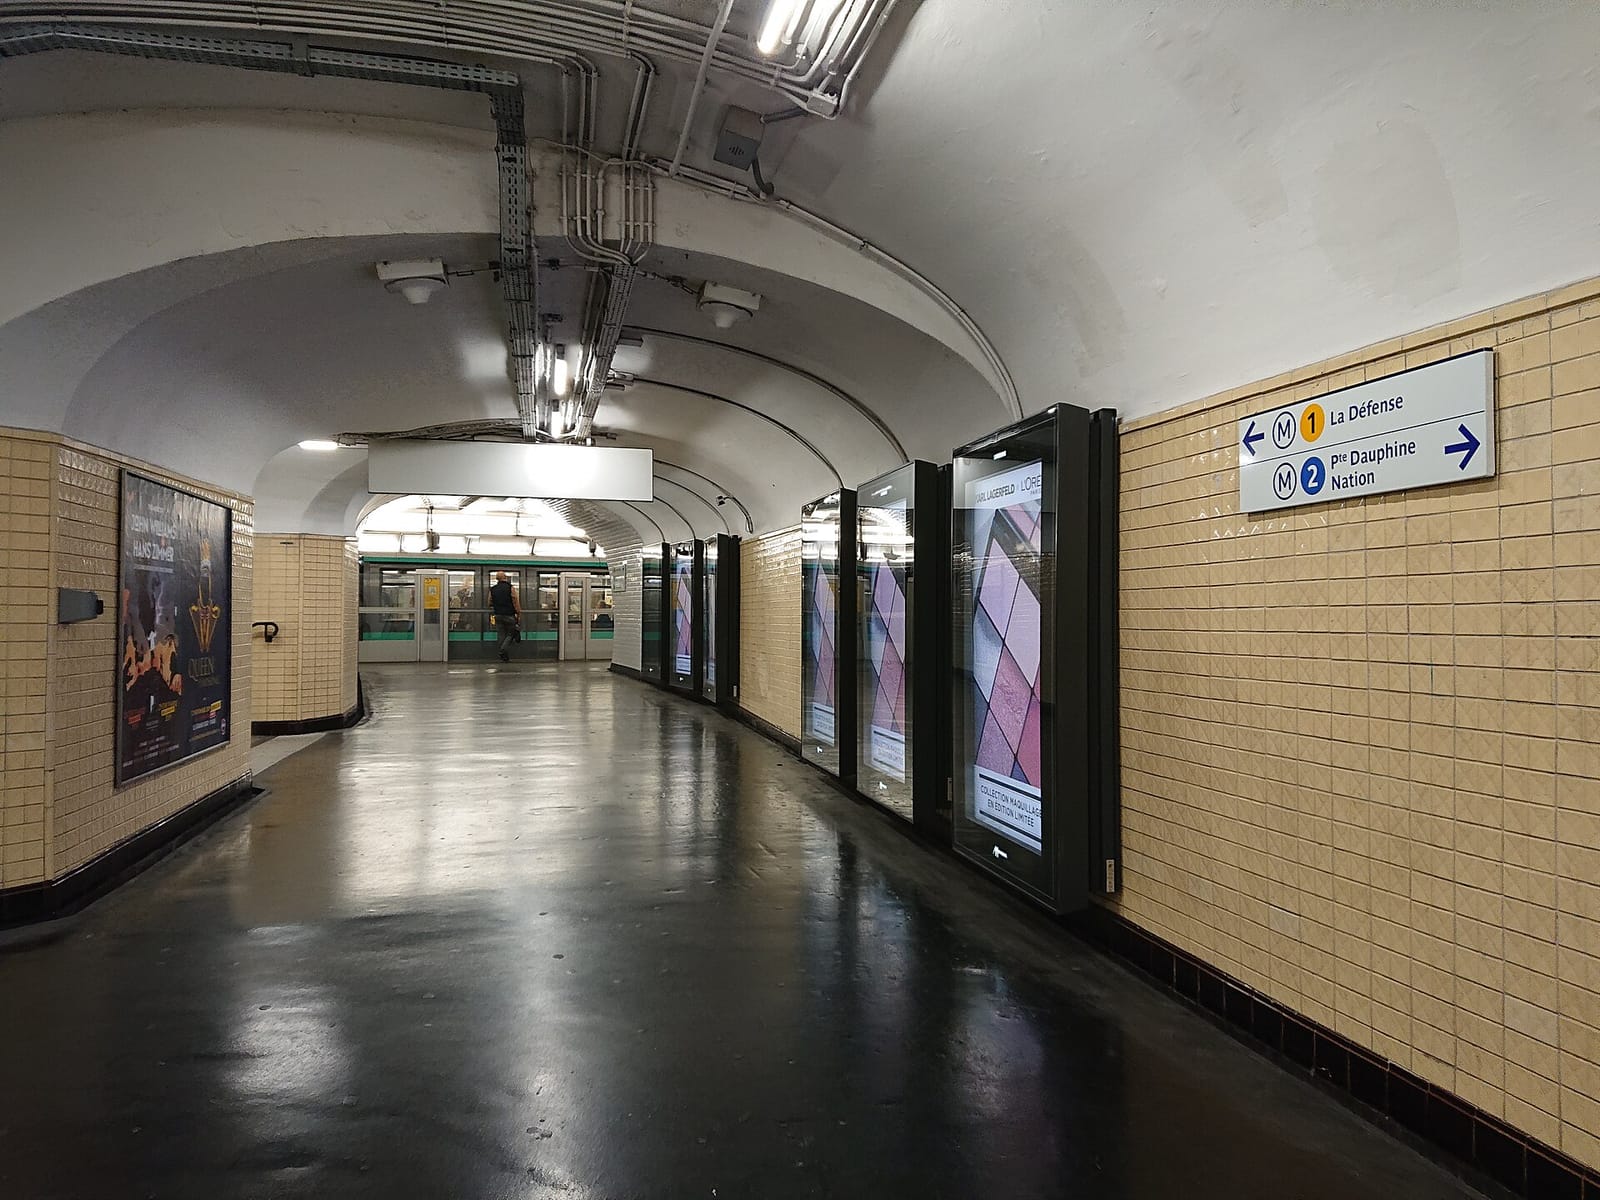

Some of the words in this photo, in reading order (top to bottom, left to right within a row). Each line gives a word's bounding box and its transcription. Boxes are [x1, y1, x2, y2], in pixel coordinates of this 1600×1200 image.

[1307, 411, 1316, 434] 1
[1330, 409, 1344, 427] La
[1349, 394, 1404, 421] Défense
[1307, 464, 1319, 489] 2
[1330, 452, 1348, 470] Pte
[1350, 439, 1416, 467] Dauphine
[1331, 469, 1376, 491] Nation
[133, 539, 152, 559] HANS
[188, 656, 215, 682] QUEEN
[980, 784, 1010, 804] COLLECTION
[987, 798, 995, 809] EN
